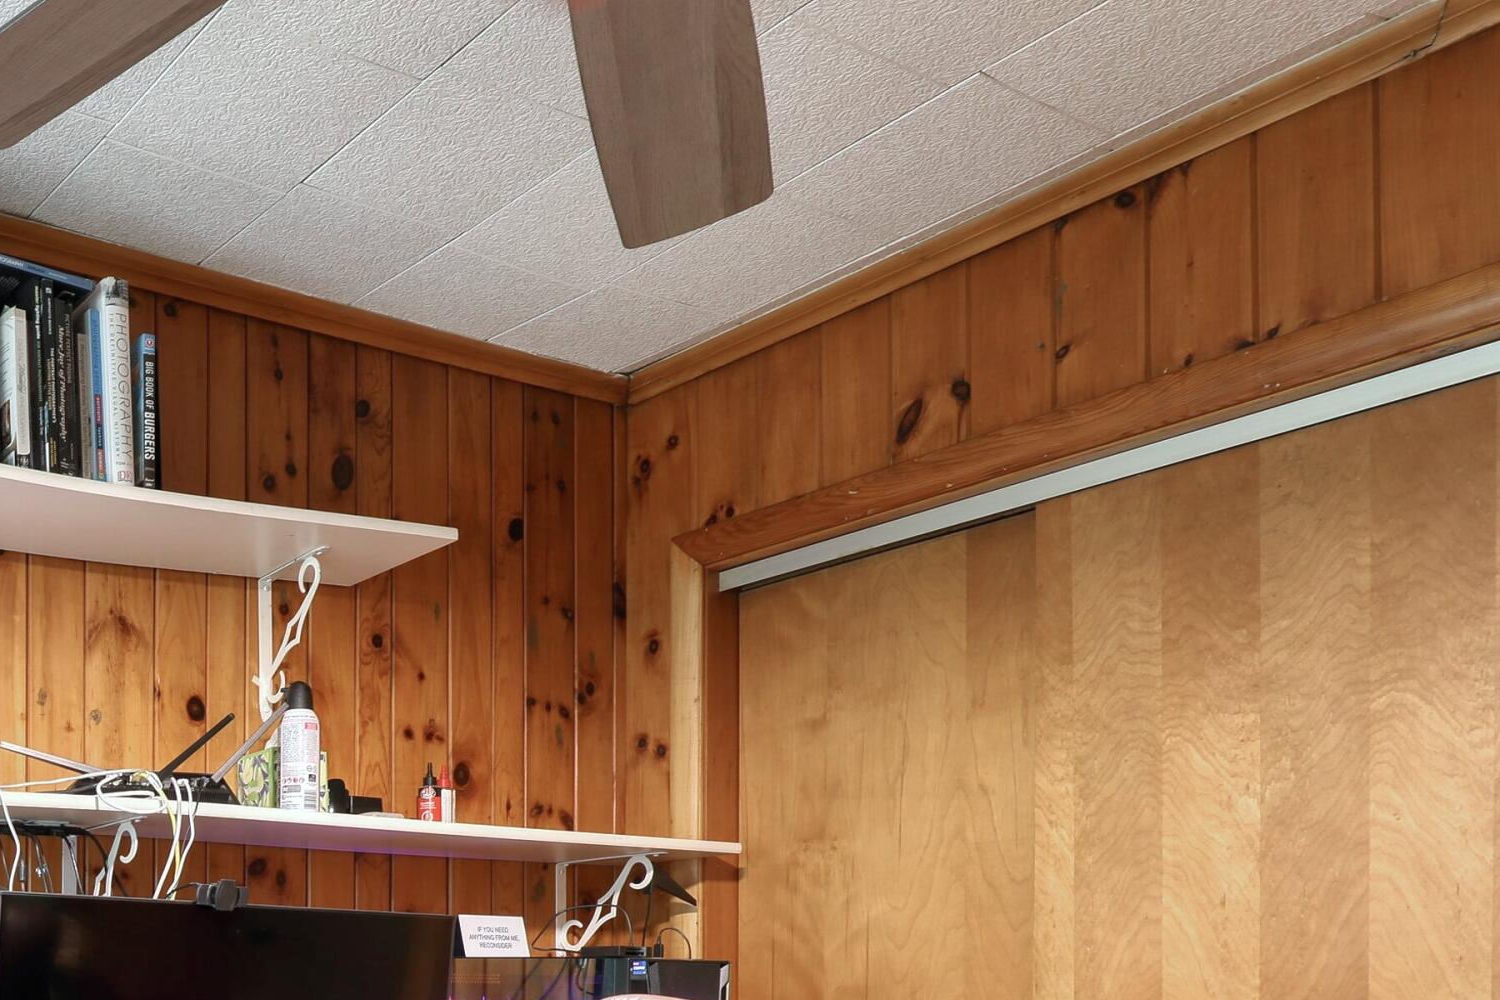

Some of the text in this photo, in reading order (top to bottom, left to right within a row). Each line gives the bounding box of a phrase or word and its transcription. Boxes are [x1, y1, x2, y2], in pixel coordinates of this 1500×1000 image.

[59, 380, 68, 442] Photography
[116, 312, 132, 458] PHOTOGRAPHY
[144, 361, 156, 461] BIG BOOK OF BURGERS
